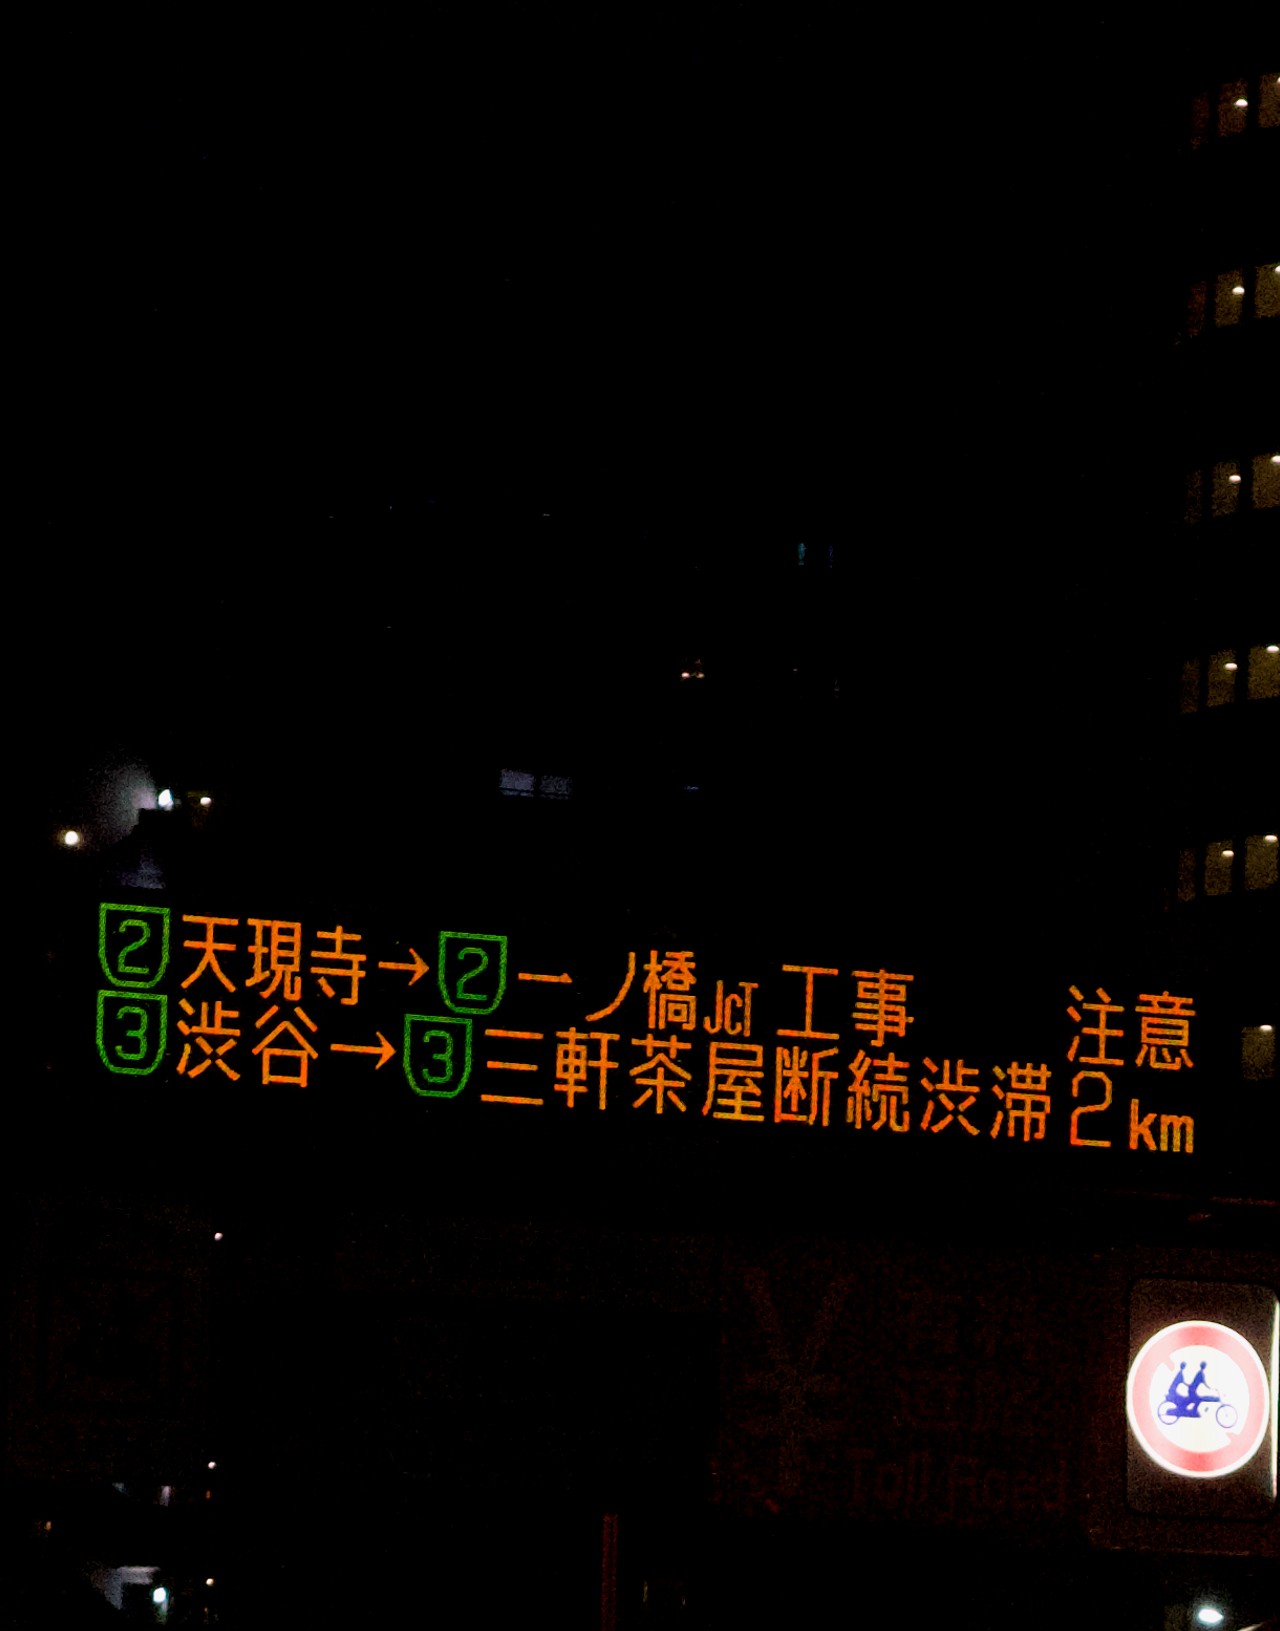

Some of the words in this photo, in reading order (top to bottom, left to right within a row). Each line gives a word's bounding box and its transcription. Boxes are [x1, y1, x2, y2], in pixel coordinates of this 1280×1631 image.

[115, 1006, 148, 1060] 3
[176, 998, 318, 1088] 渋谷
[422, 1029, 453, 1083] 3
[117, 919, 150, 974] 2
[181, 914, 367, 1005] 天現寺
[456, 947, 488, 1000] 2
[776, 964, 914, 1047] 工事
[1066, 985, 1196, 1070] 注意
